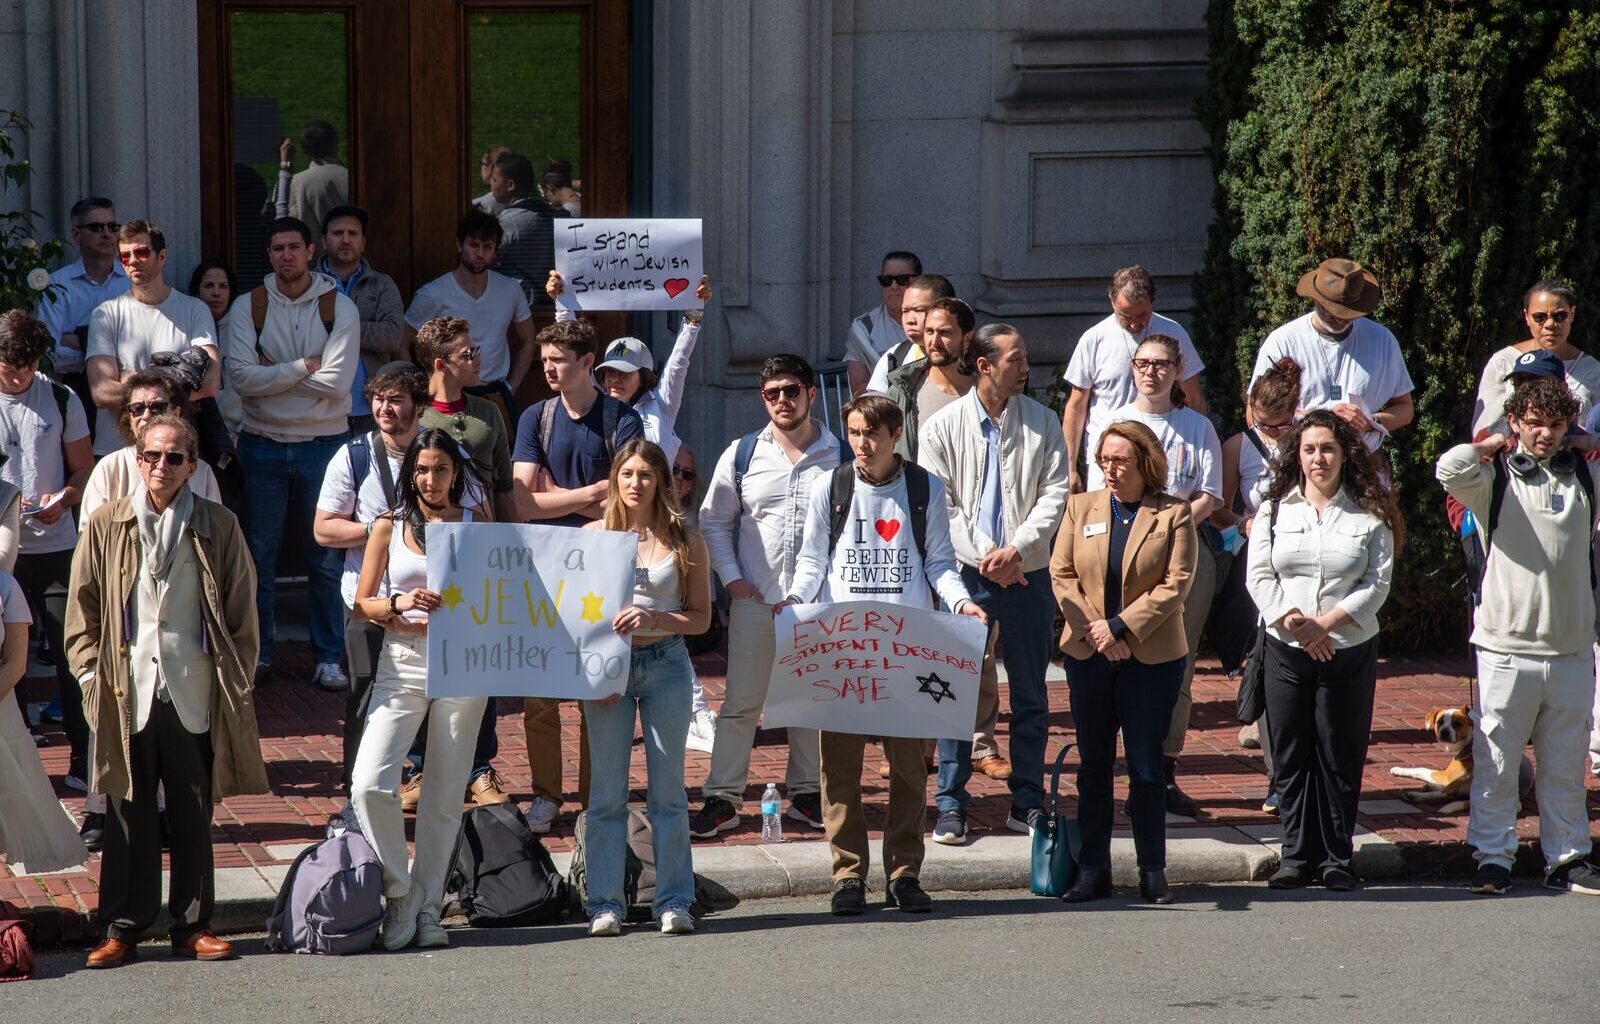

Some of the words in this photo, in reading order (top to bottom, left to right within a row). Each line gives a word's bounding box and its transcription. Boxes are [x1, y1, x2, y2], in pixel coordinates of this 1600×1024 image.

[567, 223, 587, 252] I
[593, 229, 650, 251] stand
[592, 256, 630, 272] with
[634, 253, 690, 271] Jewish
[571, 275, 655, 294] Students
[855, 518, 867, 544] I
[449, 532, 457, 572] I
[487, 545, 534, 574] am
[563, 548, 585, 571] a
[845, 548, 910, 565] BEING
[840, 566, 914, 583] JEWISH
[469, 576, 565, 628] JEW
[793, 610, 904, 649] EVERY
[441, 638, 449, 676] I
[464, 634, 555, 673] matter
[566, 636, 624, 680] too
[779, 638, 880, 666] STUDENT
[892, 641, 979, 675] DESERVES
[791, 663, 819, 678] TO
[832, 657, 905, 671] FEEL
[811, 675, 890, 704] SAFE
